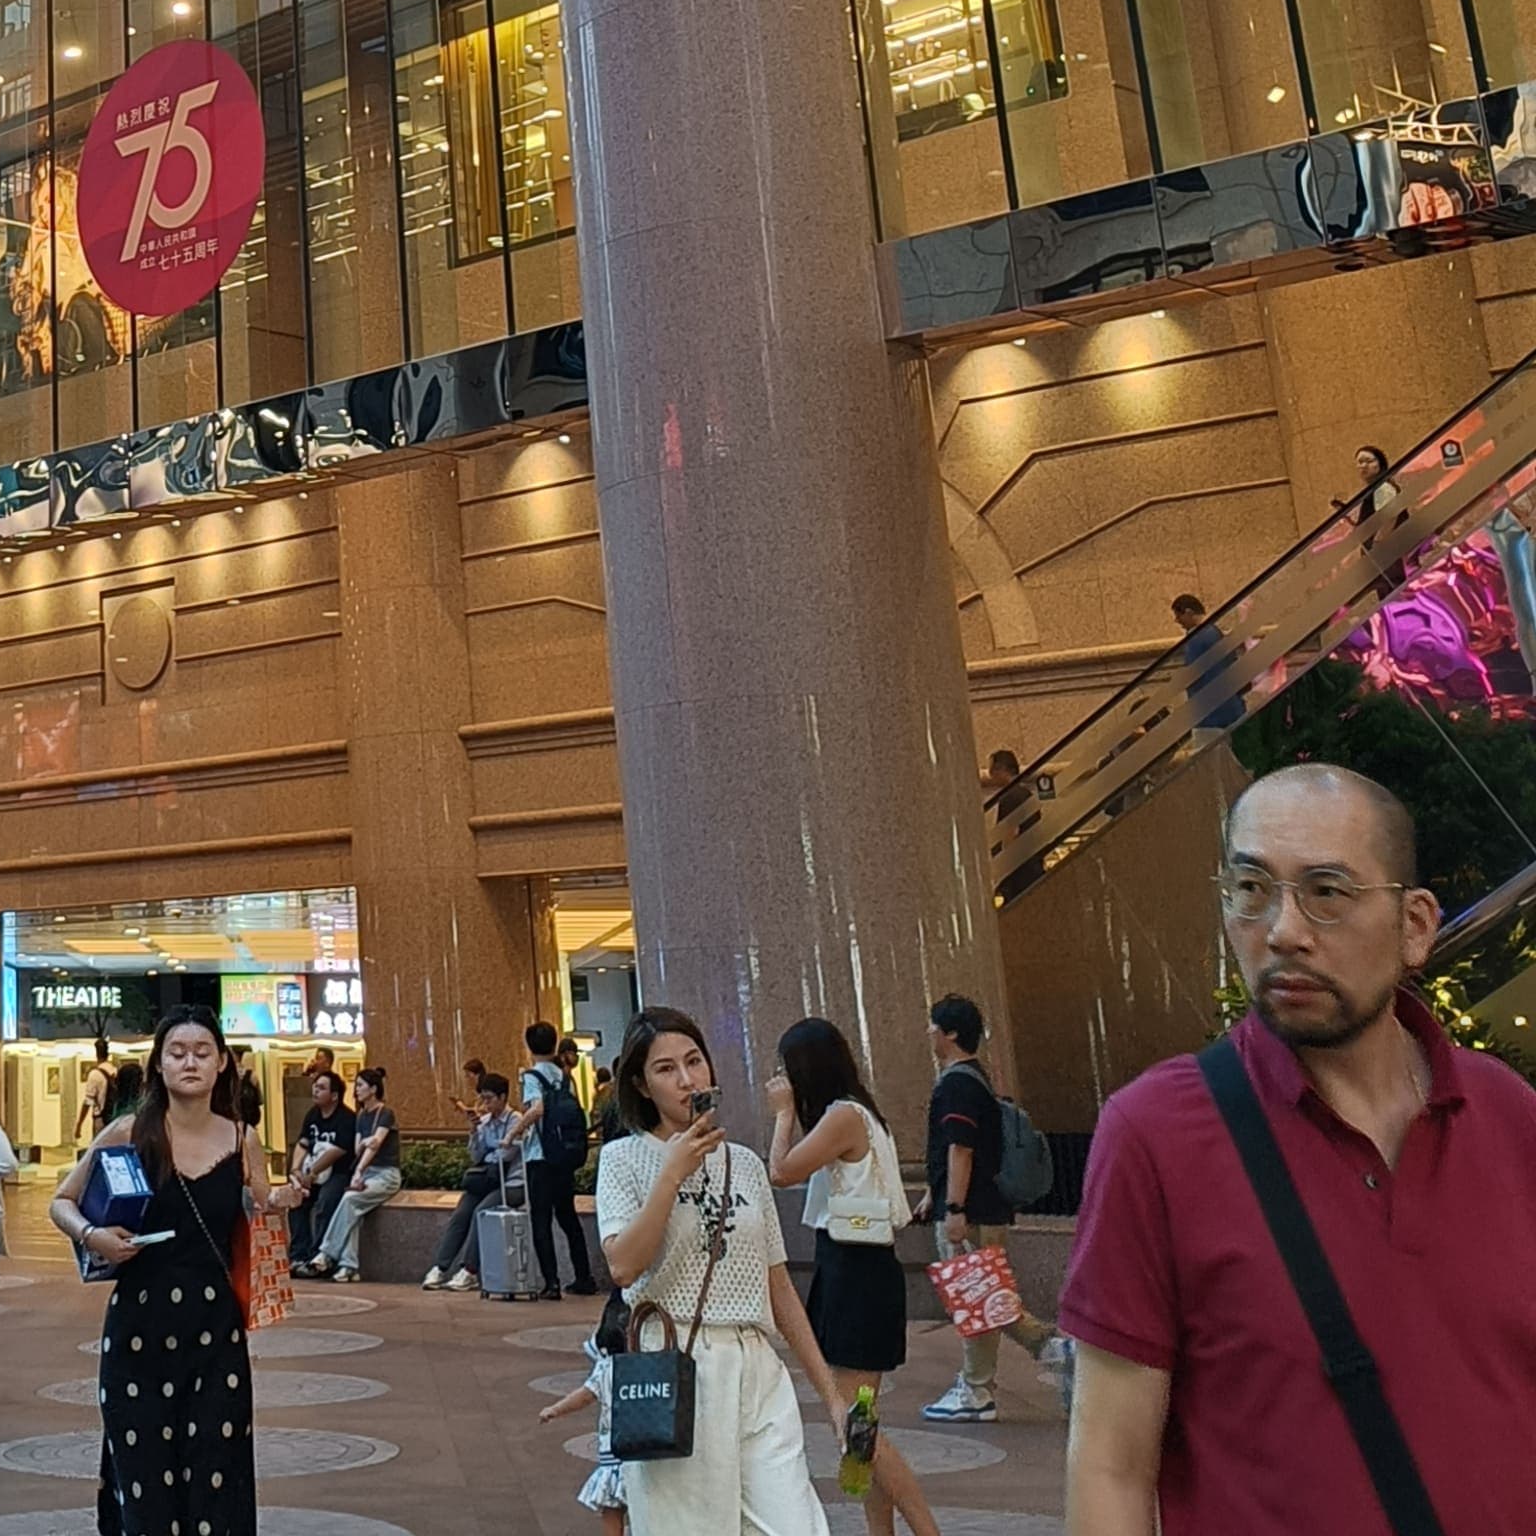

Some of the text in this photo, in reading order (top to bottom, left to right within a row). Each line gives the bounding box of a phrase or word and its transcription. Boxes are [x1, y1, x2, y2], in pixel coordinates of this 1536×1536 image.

[116, 96, 171, 132] 熱烈慶祝
[114, 80, 219, 263] 75
[32, 986, 122, 1009] THEATRE
[677, 1191, 749, 1209] PRADA
[619, 1382, 671, 1400] CELINE
